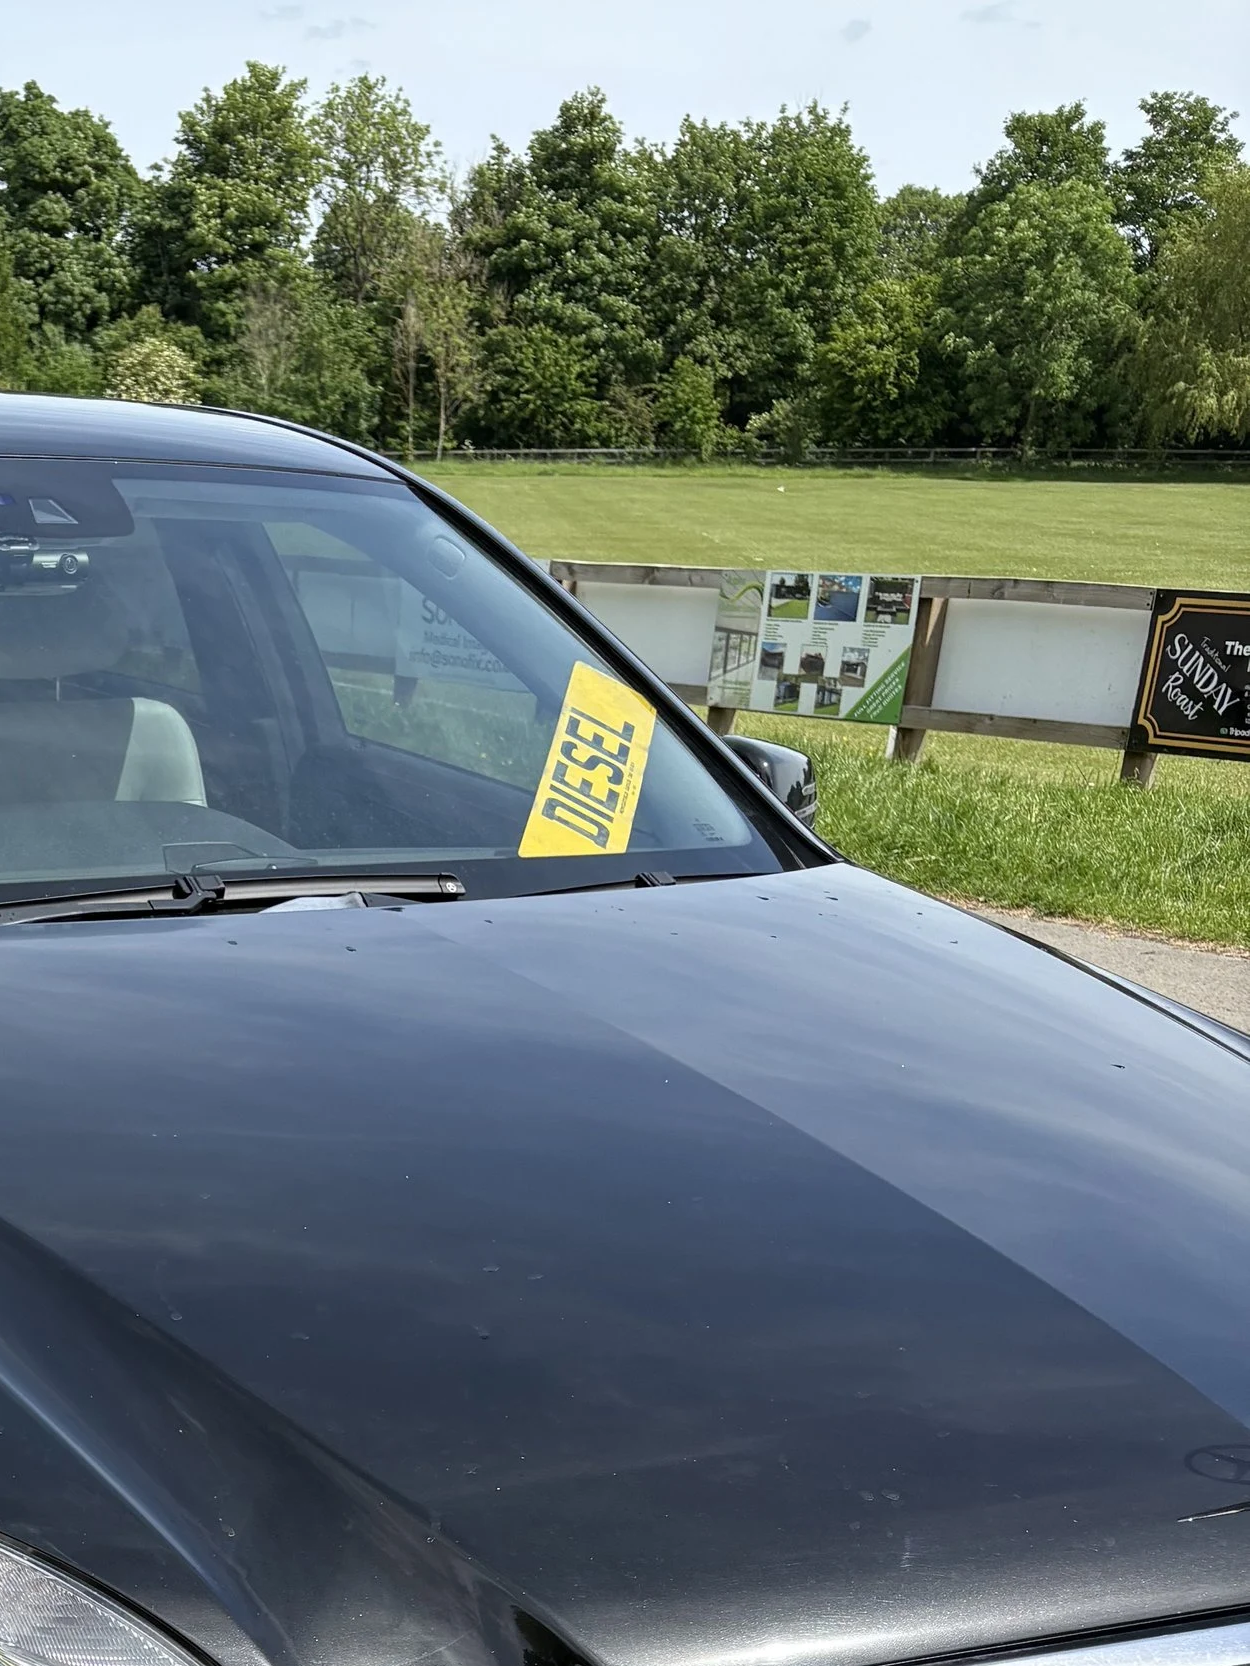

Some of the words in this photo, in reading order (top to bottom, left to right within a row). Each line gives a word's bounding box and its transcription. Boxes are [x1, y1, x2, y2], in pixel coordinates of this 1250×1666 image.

[1200, 636, 1231, 672] Traditional
[1225, 640, 1250, 657] The
[1161, 671, 1204, 721] Roast
[1165, 633, 1240, 716] SUNDAY
[541, 706, 635, 850] DIESEL
